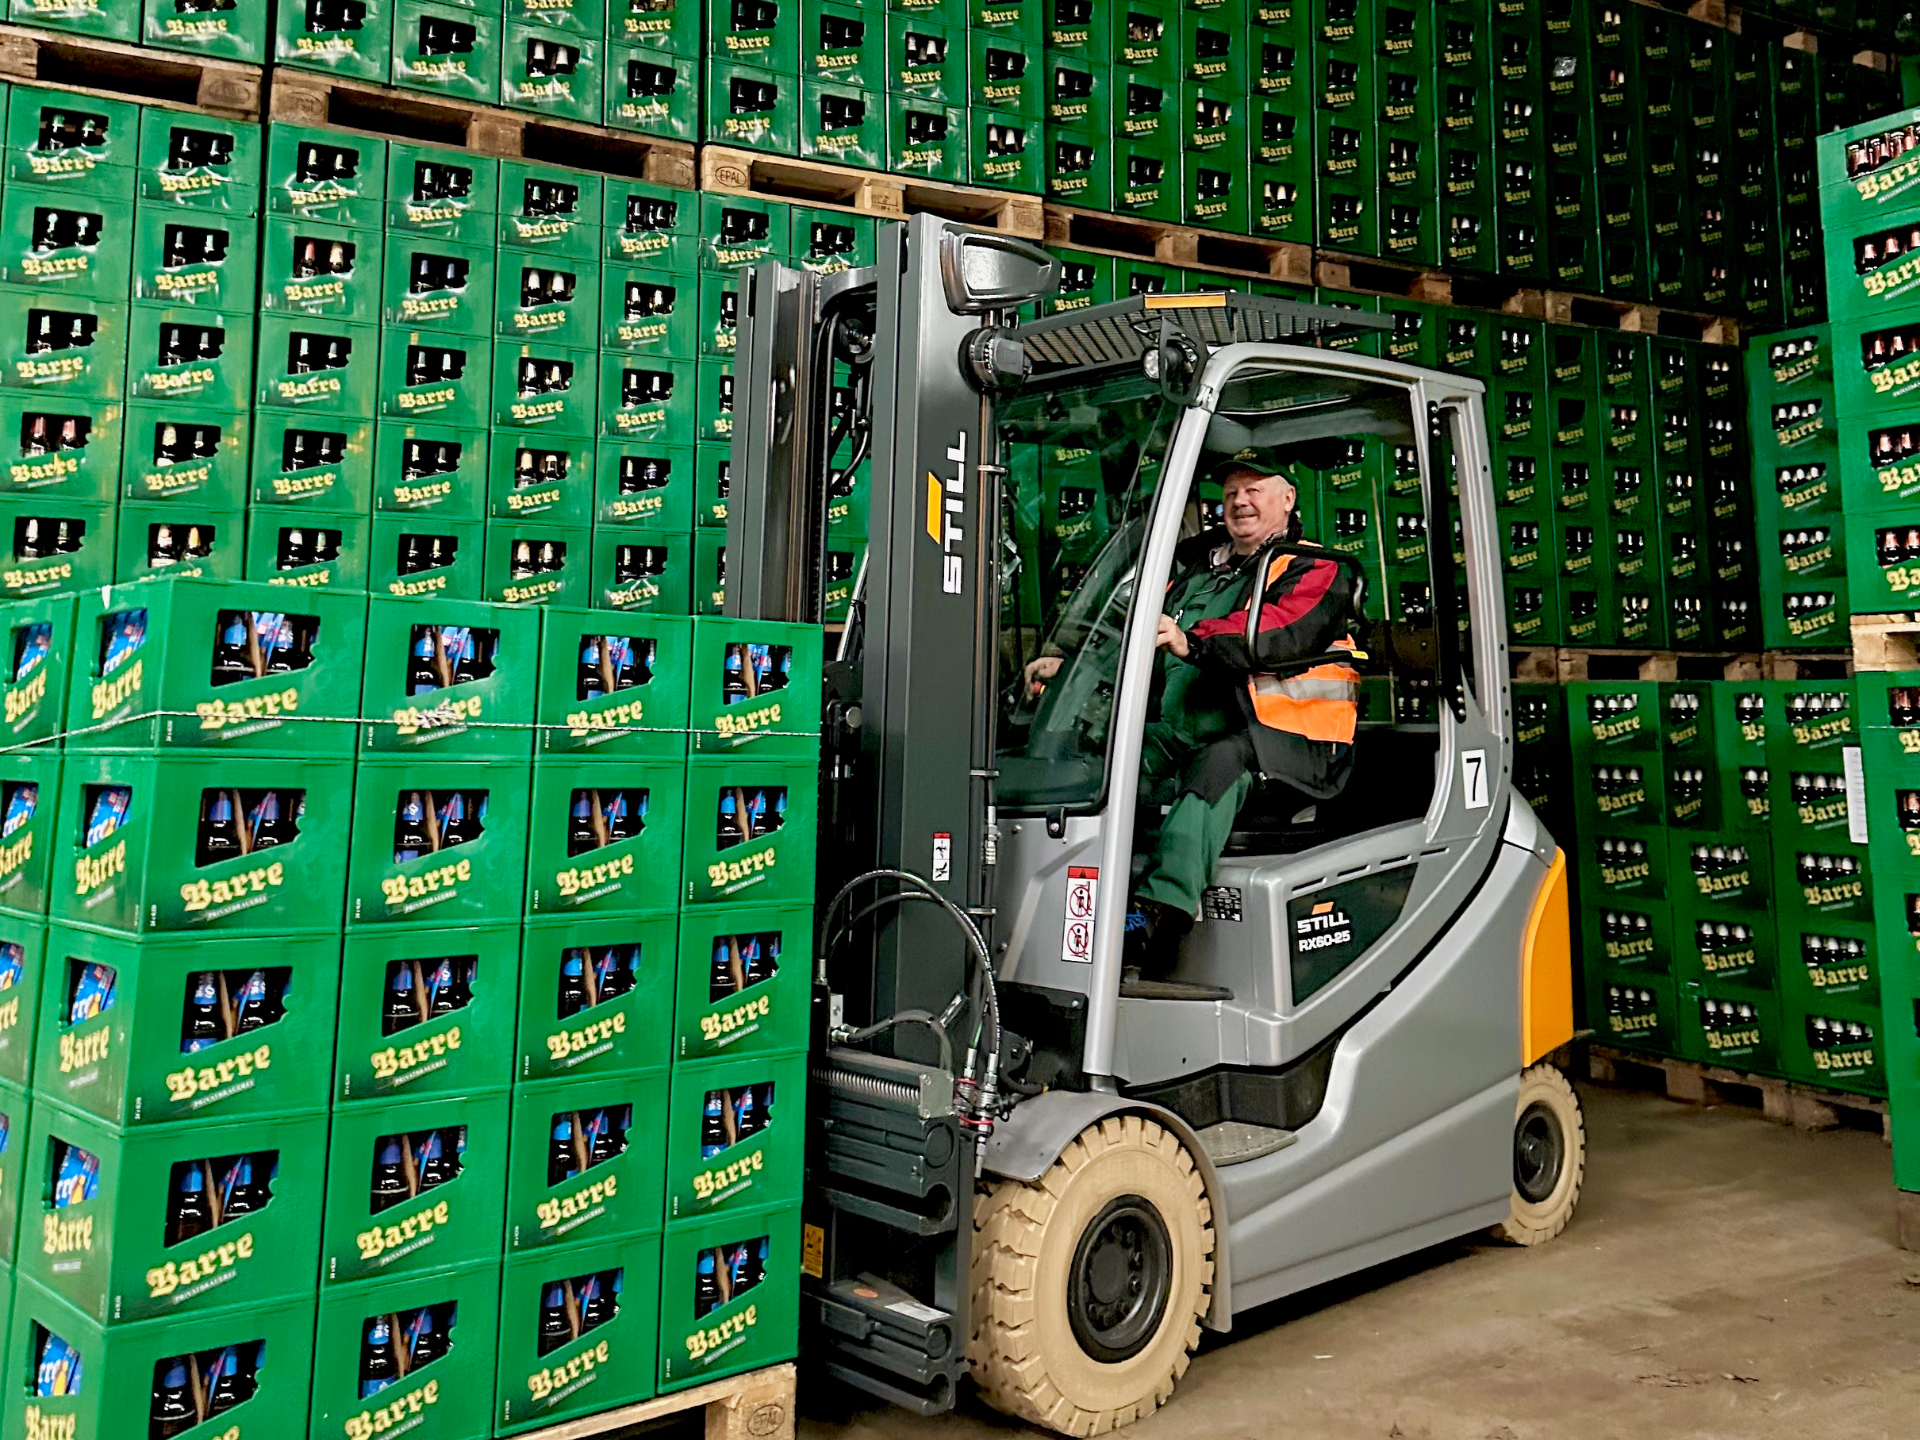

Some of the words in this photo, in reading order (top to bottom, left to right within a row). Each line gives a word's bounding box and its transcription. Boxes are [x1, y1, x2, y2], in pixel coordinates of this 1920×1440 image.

[625, 19, 671, 33] Barre
[982, 11, 1018, 22] Barre
[166, 20, 227, 35] Barre
[296, 37, 353, 52] Barre
[726, 36, 769, 49] Barre
[1052, 31, 1087, 46] Barre
[816, 54, 857, 68] Barre
[1124, 48, 1158, 63] Barre
[413, 61, 466, 76] Barre
[901, 71, 940, 87] Barre
[521, 83, 571, 97] Barre
[983, 85, 1020, 103] Barre
[1052, 104, 1087, 116] Barre
[817, 135, 858, 150] Barre
[32, 156, 96, 173] Barre
[983, 161, 1020, 178] Barre
[161, 175, 221, 192] Barre
[720, 170, 741, 184] EPAL
[1052, 178, 1087, 194] Barre
[1857, 157, 1920, 200] Barr
[1124, 190, 1158, 203] Barre
[407, 205, 464, 223] Barre
[516, 221, 569, 238] Barre
[620, 235, 668, 253] Barre
[715, 248, 761, 263] Barre
[23, 257, 87, 276] Barre
[1863, 256, 1920, 297] Barr
[156, 271, 216, 290] Barre
[285, 281, 343, 301] Barre
[402, 298, 456, 316] Barre
[1054, 297, 1090, 311] Barre
[514, 311, 565, 328] Barre
[618, 324, 666, 341] Barre
[18, 357, 84, 378] Barre
[1775, 357, 1818, 382] Barre
[1871, 357, 1920, 393] Bar
[151, 369, 213, 390] Barre
[280, 379, 339, 397] Barre
[398, 389, 454, 408] Barre
[511, 401, 562, 418] Barre
[616, 410, 664, 429] Barre
[1779, 419, 1822, 445] Barre
[11, 456, 77, 481] Barre
[145, 468, 209, 490] Barre
[273, 473, 334, 495] Barre
[394, 482, 450, 502] Barre
[507, 490, 559, 509] Barre
[613, 497, 661, 516] Barre
[1781, 484, 1826, 508] Barre
[943, 431, 966, 594] STILL
[1786, 548, 1830, 571] Barre
[4, 564, 71, 587] Barre
[389, 576, 445, 596] Barre
[503, 581, 557, 602] Barre
[610, 585, 657, 605] Barre
[1790, 613, 1834, 634] Barre
[5, 665, 46, 723] Barre
[92, 659, 143, 719] Barre
[196, 688, 298, 729] Barre
[567, 701, 642, 736] Barre
[716, 705, 780, 738] Barre
[1593, 717, 1640, 740] Barre
[1794, 718, 1850, 744] Barre
[1466, 757, 1481, 801] 7
[1599, 791, 1645, 811] Barre
[1799, 801, 1848, 824] Barr
[76, 841, 126, 895] Barre
[557, 855, 632, 896] Barre
[709, 849, 774, 887] Barre
[1604, 864, 1648, 883] Barre
[181, 862, 282, 911] Barre
[381, 859, 471, 905] Barre
[1698, 872, 1749, 893] Barre
[1805, 882, 1861, 904] Barre
[1297, 912, 1350, 933] STILL
[1298, 930, 1351, 952] RX60-25
[1607, 939, 1652, 957] Barre
[1703, 950, 1754, 971] Barre
[1811, 965, 1867, 986] Barre
[701, 996, 768, 1040] Barre
[1612, 1015, 1656, 1031] Barre
[548, 1013, 624, 1059] Barre
[1708, 1031, 1759, 1048] Barre
[61, 1027, 110, 1073] Barre
[371, 1026, 461, 1079] Barre
[1814, 1051, 1872, 1069] Barre
[166, 1044, 270, 1102] Barre
[694, 1151, 762, 1199] Barre
[537, 1176, 616, 1228] Barre
[43, 1213, 93, 1256] Barre
[357, 1201, 448, 1260] Barre
[146, 1232, 254, 1299] Barre
[686, 1305, 756, 1359] Barre
[529, 1341, 608, 1401] Barre
[345, 1380, 438, 1440] Barre
